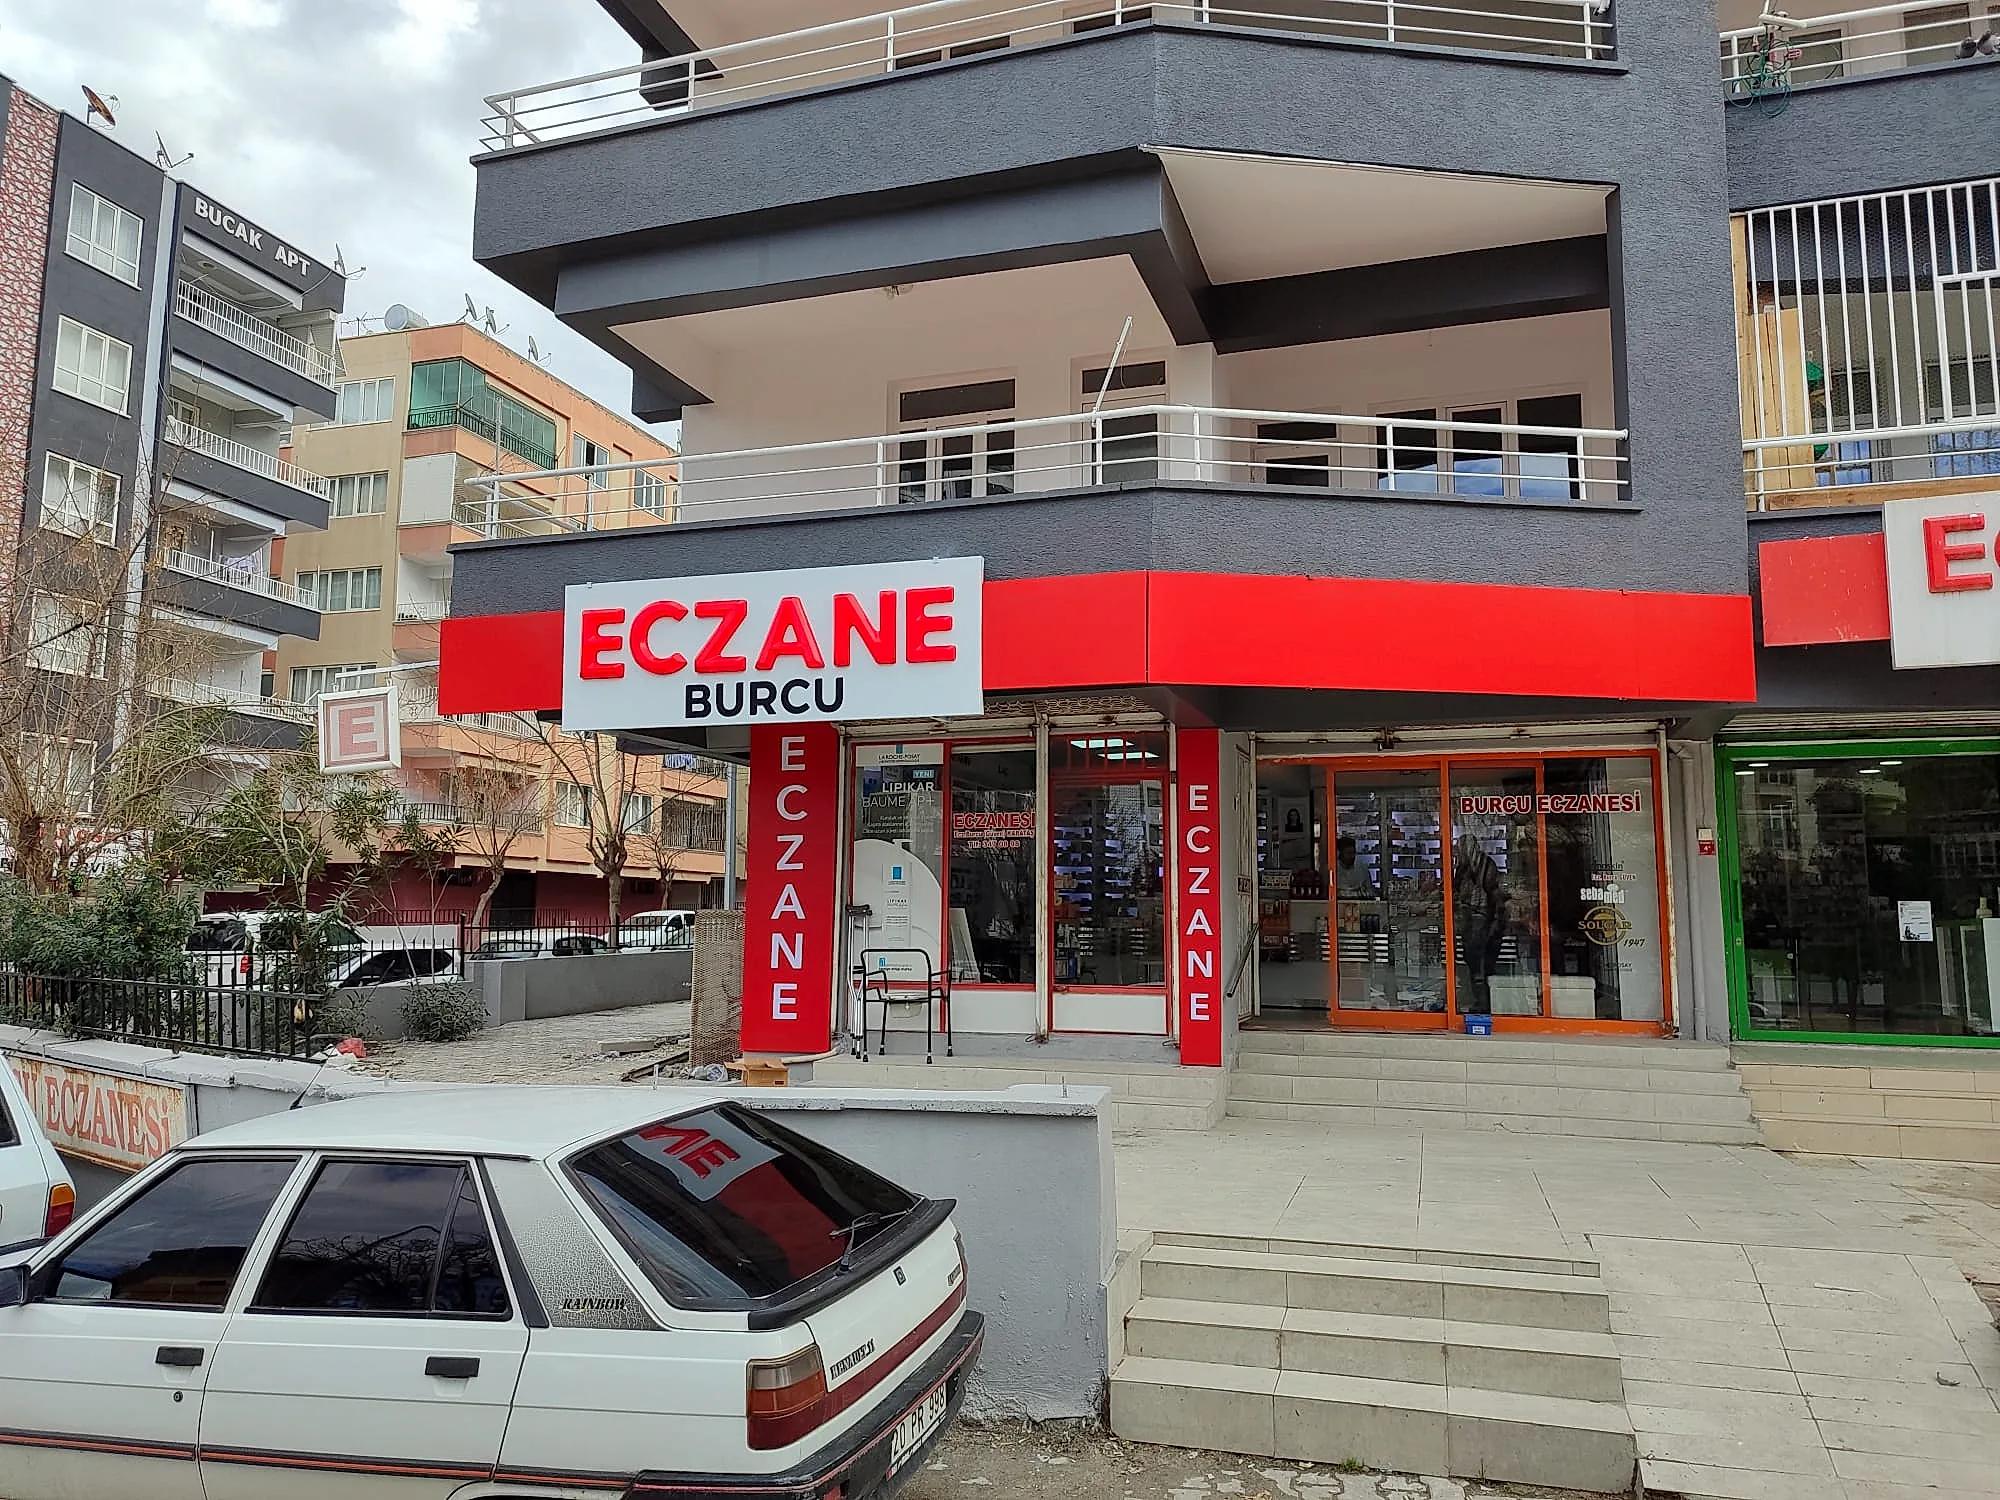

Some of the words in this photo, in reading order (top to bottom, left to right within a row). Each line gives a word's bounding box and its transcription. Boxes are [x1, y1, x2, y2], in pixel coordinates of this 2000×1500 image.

[194, 197, 263, 251] BUCAK
[274, 245, 311, 276] APT
[1923, 512, 2000, 593] E
[580, 586, 957, 679] ECZANE
[684, 677, 844, 719] BURCU
[338, 706, 378, 756] E
[862, 795, 905, 808] BAUME
[882, 782, 935, 793] LIPIKAR
[1460, 795, 1532, 815] BURCU
[1536, 789, 1642, 814] ECZANESİ
[770, 735, 808, 1020] ECZANE
[1186, 784, 1213, 1021] ECZANE
[1624, 939, 1646, 948] 1947
[45, 1075, 171, 1157] ECZANESİ
[562, 1298, 627, 1311] RAINBOW
[892, 1421, 906, 1457] 20
[911, 1405, 925, 1441] PR
[929, 1384, 945, 1421] 998
